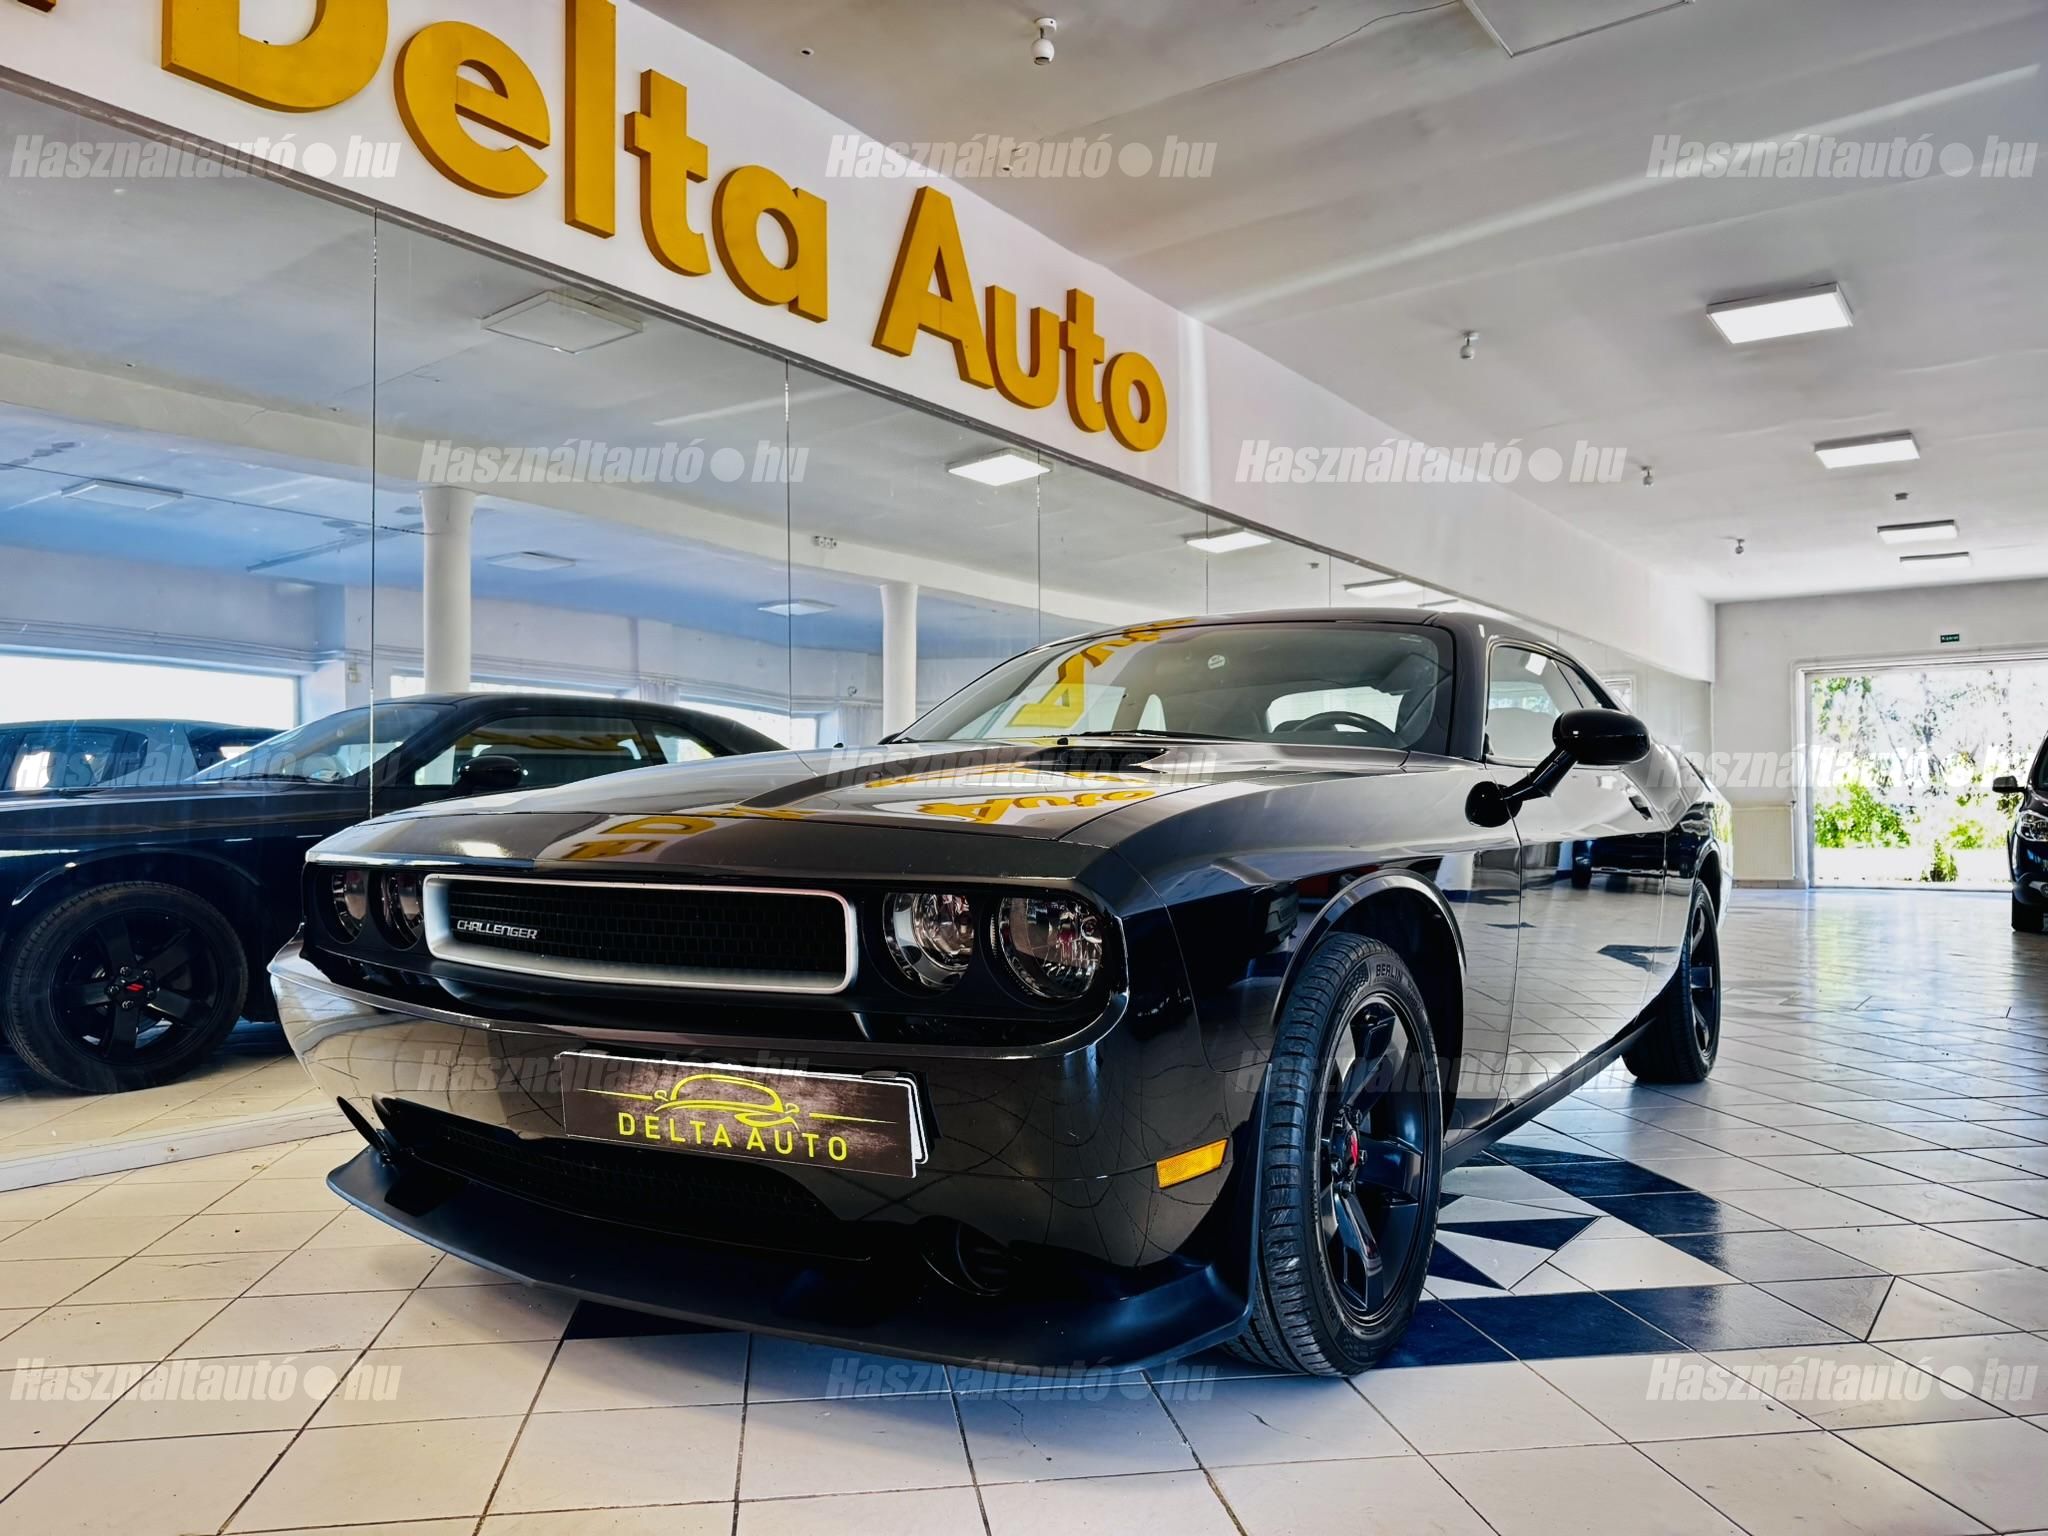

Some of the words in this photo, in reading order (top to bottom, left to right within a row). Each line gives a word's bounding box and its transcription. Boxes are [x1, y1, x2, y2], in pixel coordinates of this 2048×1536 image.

[871, 186, 1167, 452] Auto
[456, 919, 538, 939] CHALLENGER
[618, 1112, 733, 1148] DELTA
[746, 1127, 848, 1161] AUTO
